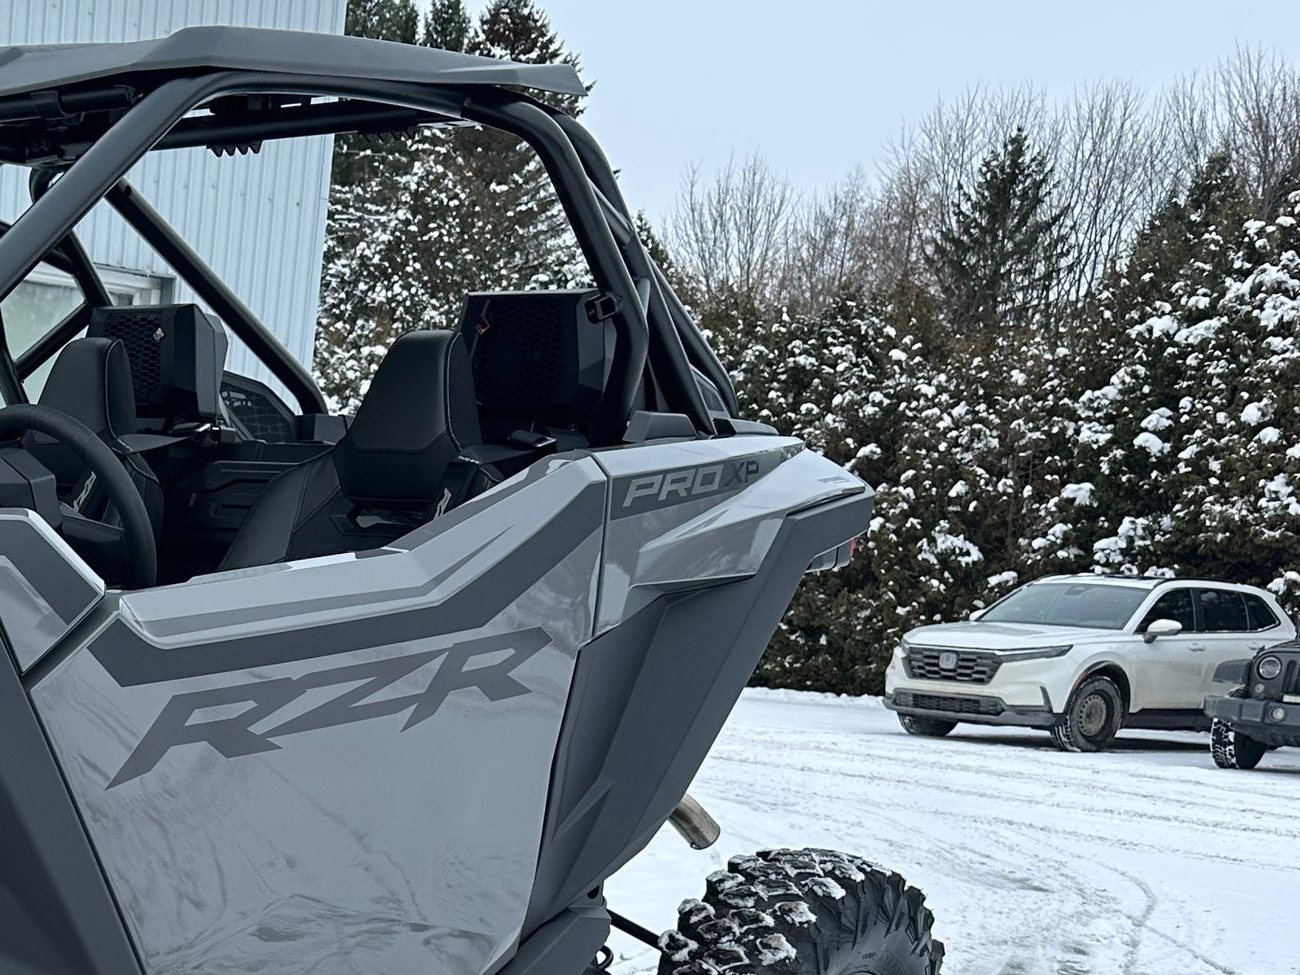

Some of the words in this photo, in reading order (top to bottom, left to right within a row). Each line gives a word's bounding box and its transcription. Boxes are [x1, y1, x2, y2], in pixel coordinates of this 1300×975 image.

[622, 464, 724, 508] PRO
[724, 459, 760, 488] XP
[104, 627, 554, 791] RZR
